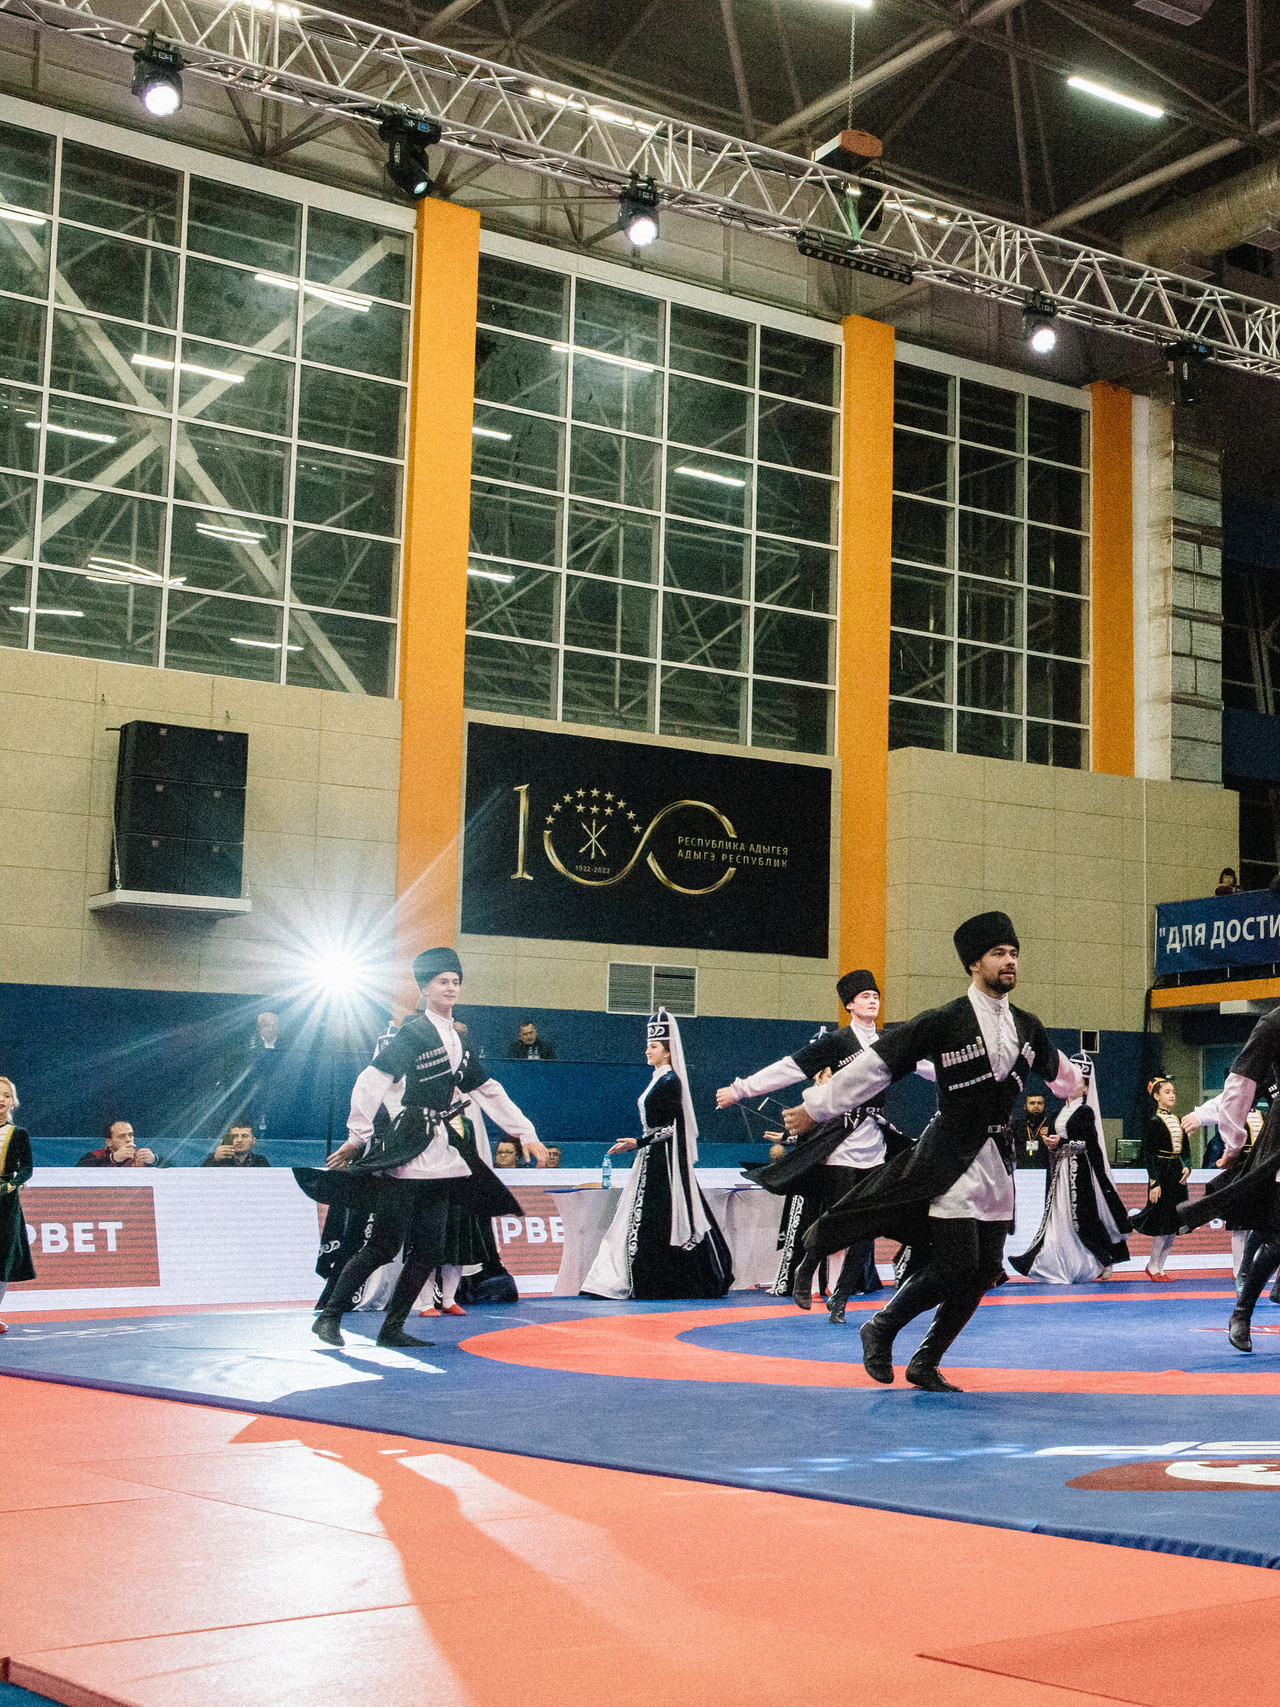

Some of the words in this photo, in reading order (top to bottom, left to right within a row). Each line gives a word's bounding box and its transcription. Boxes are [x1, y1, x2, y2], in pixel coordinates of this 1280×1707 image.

[678, 836, 746, 852] РЕСПУБЛИКА
[748, 843, 789, 856] АДЫГЕЯ
[677, 849, 715, 861] АДЫГЭ
[721, 853, 788, 867] РЕСПУБЛИК
[575, 865, 611, 874] 1922-2022
